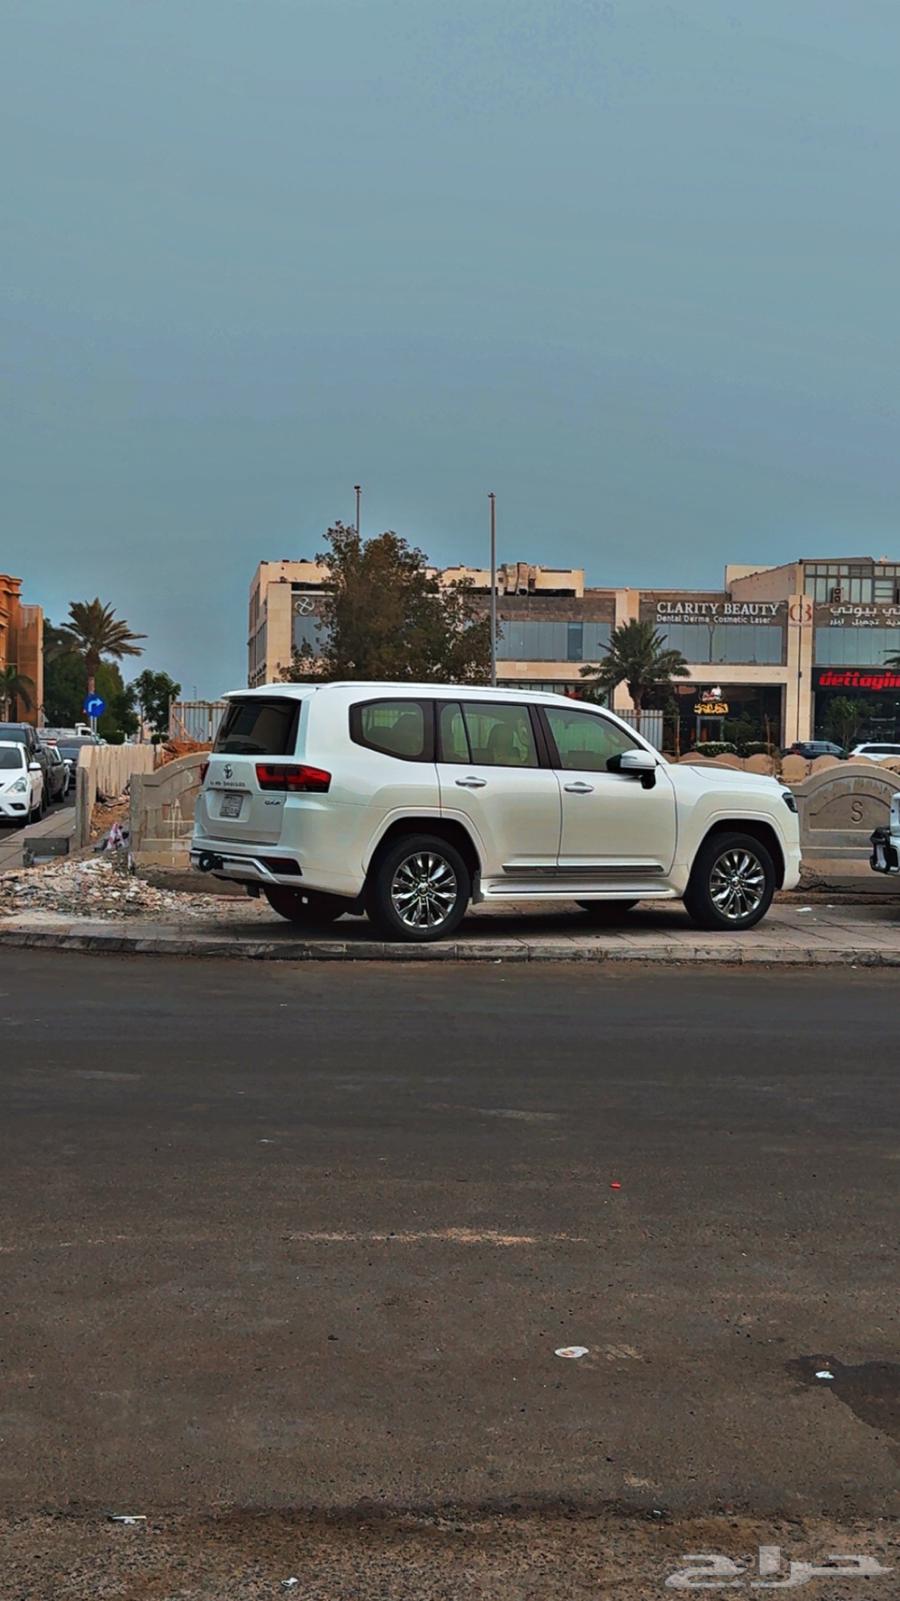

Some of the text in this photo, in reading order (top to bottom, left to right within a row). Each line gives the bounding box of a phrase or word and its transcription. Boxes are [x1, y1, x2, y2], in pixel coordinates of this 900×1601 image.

[656, 602, 779, 616] CLARITY BEAUTY
[829, 604, 878, 618] بيوتي
[656, 614, 682, 623] Dental
[683, 615, 710, 623] Derma
[713, 616, 748, 624] Cosmetic
